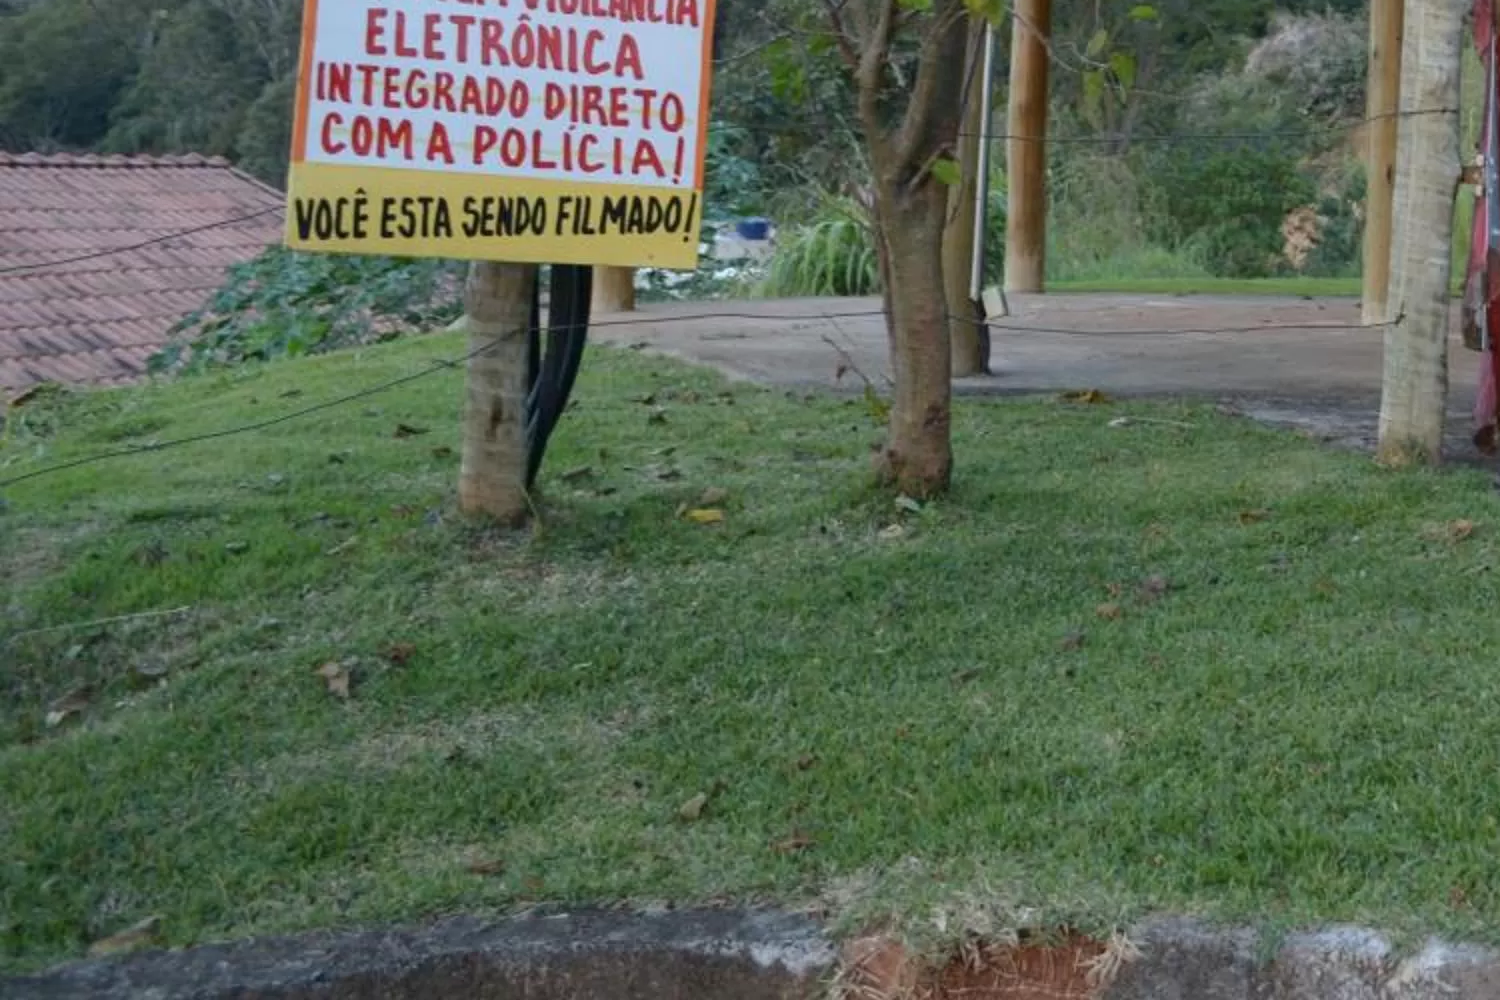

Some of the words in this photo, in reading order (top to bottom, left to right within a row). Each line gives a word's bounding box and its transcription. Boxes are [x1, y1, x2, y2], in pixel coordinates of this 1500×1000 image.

[365, 8, 645, 81] ELETRÔNICA
[316, 62, 529, 119] INTEGRADO
[544, 83, 685, 133] DIRETO
[321, 112, 414, 159] COM
[426, 122, 455, 164] A
[472, 125, 685, 184] POLÍCIA!
[294, 188, 369, 241] VOCÊ
[380, 197, 453, 238] ESTA
[461, 196, 546, 237] SENDO
[555, 192, 697, 242] FILMADO!
